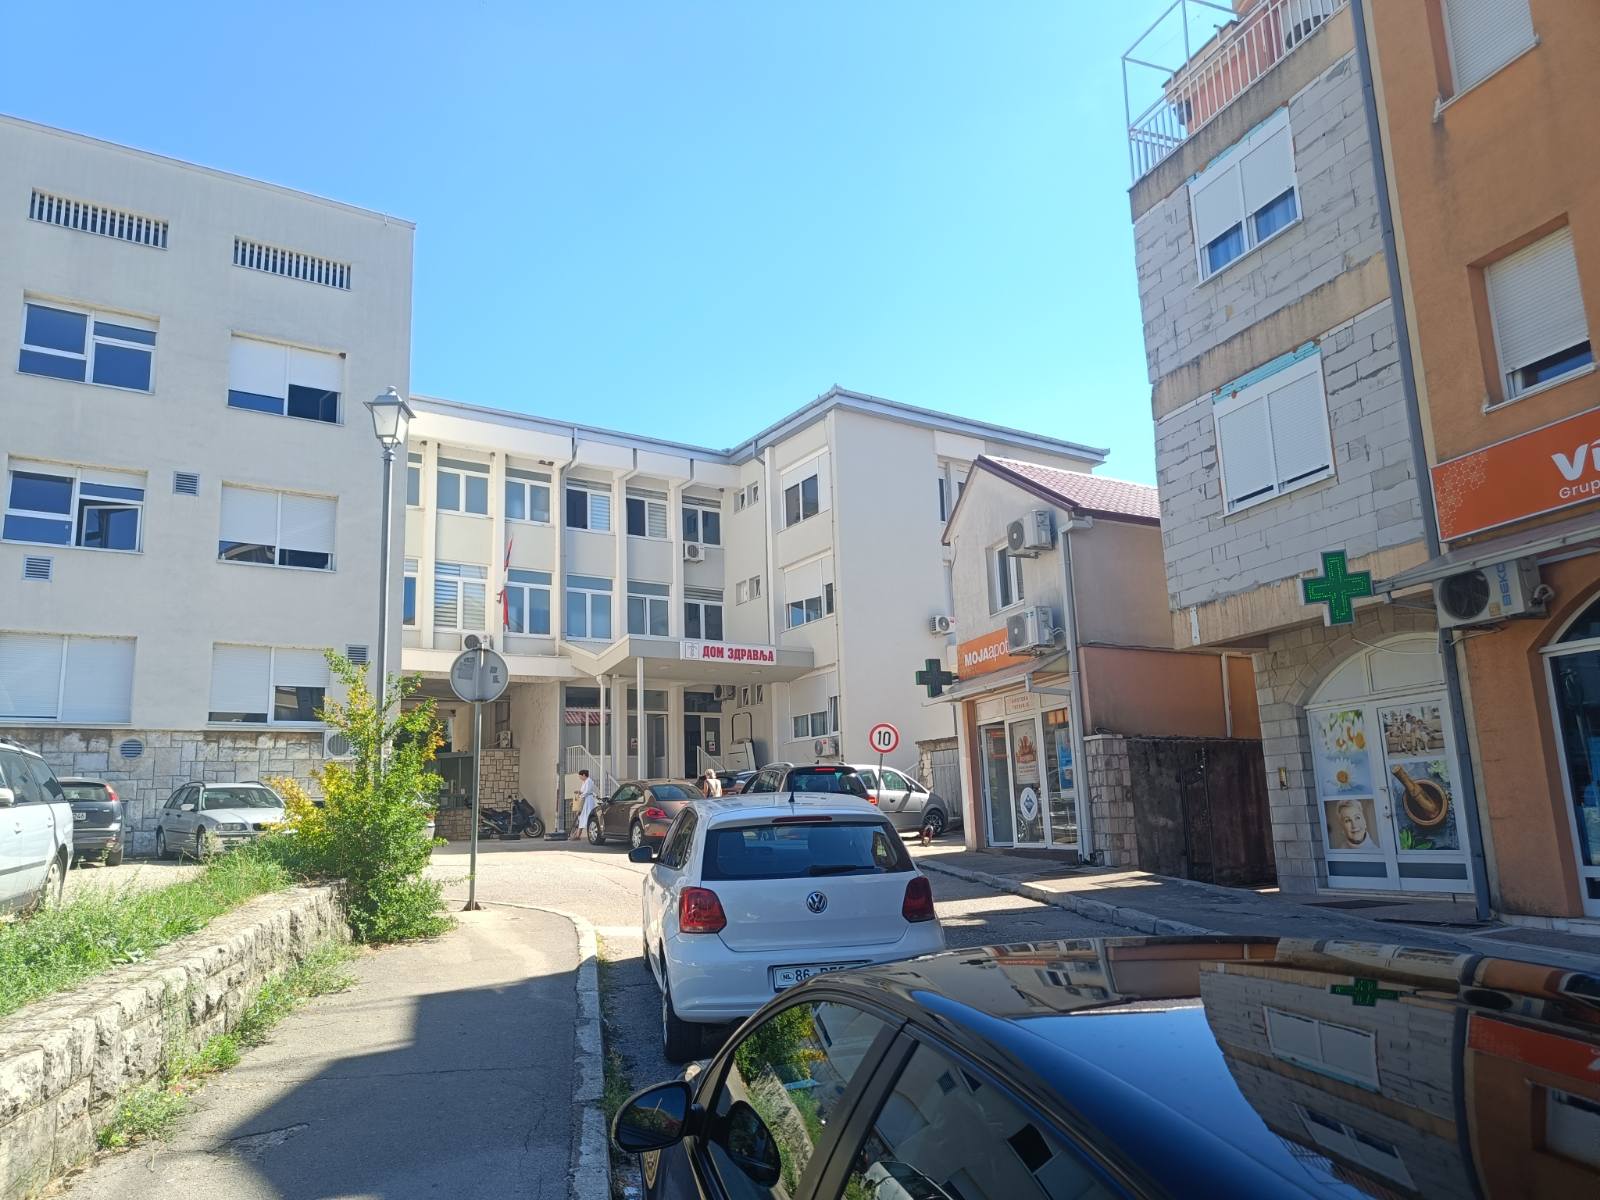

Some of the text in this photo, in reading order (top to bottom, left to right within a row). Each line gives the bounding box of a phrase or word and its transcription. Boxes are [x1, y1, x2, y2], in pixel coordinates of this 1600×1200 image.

[703, 645, 775, 662] ДОМ ЗДРАВЉА
[878, 730, 891, 746] 10
